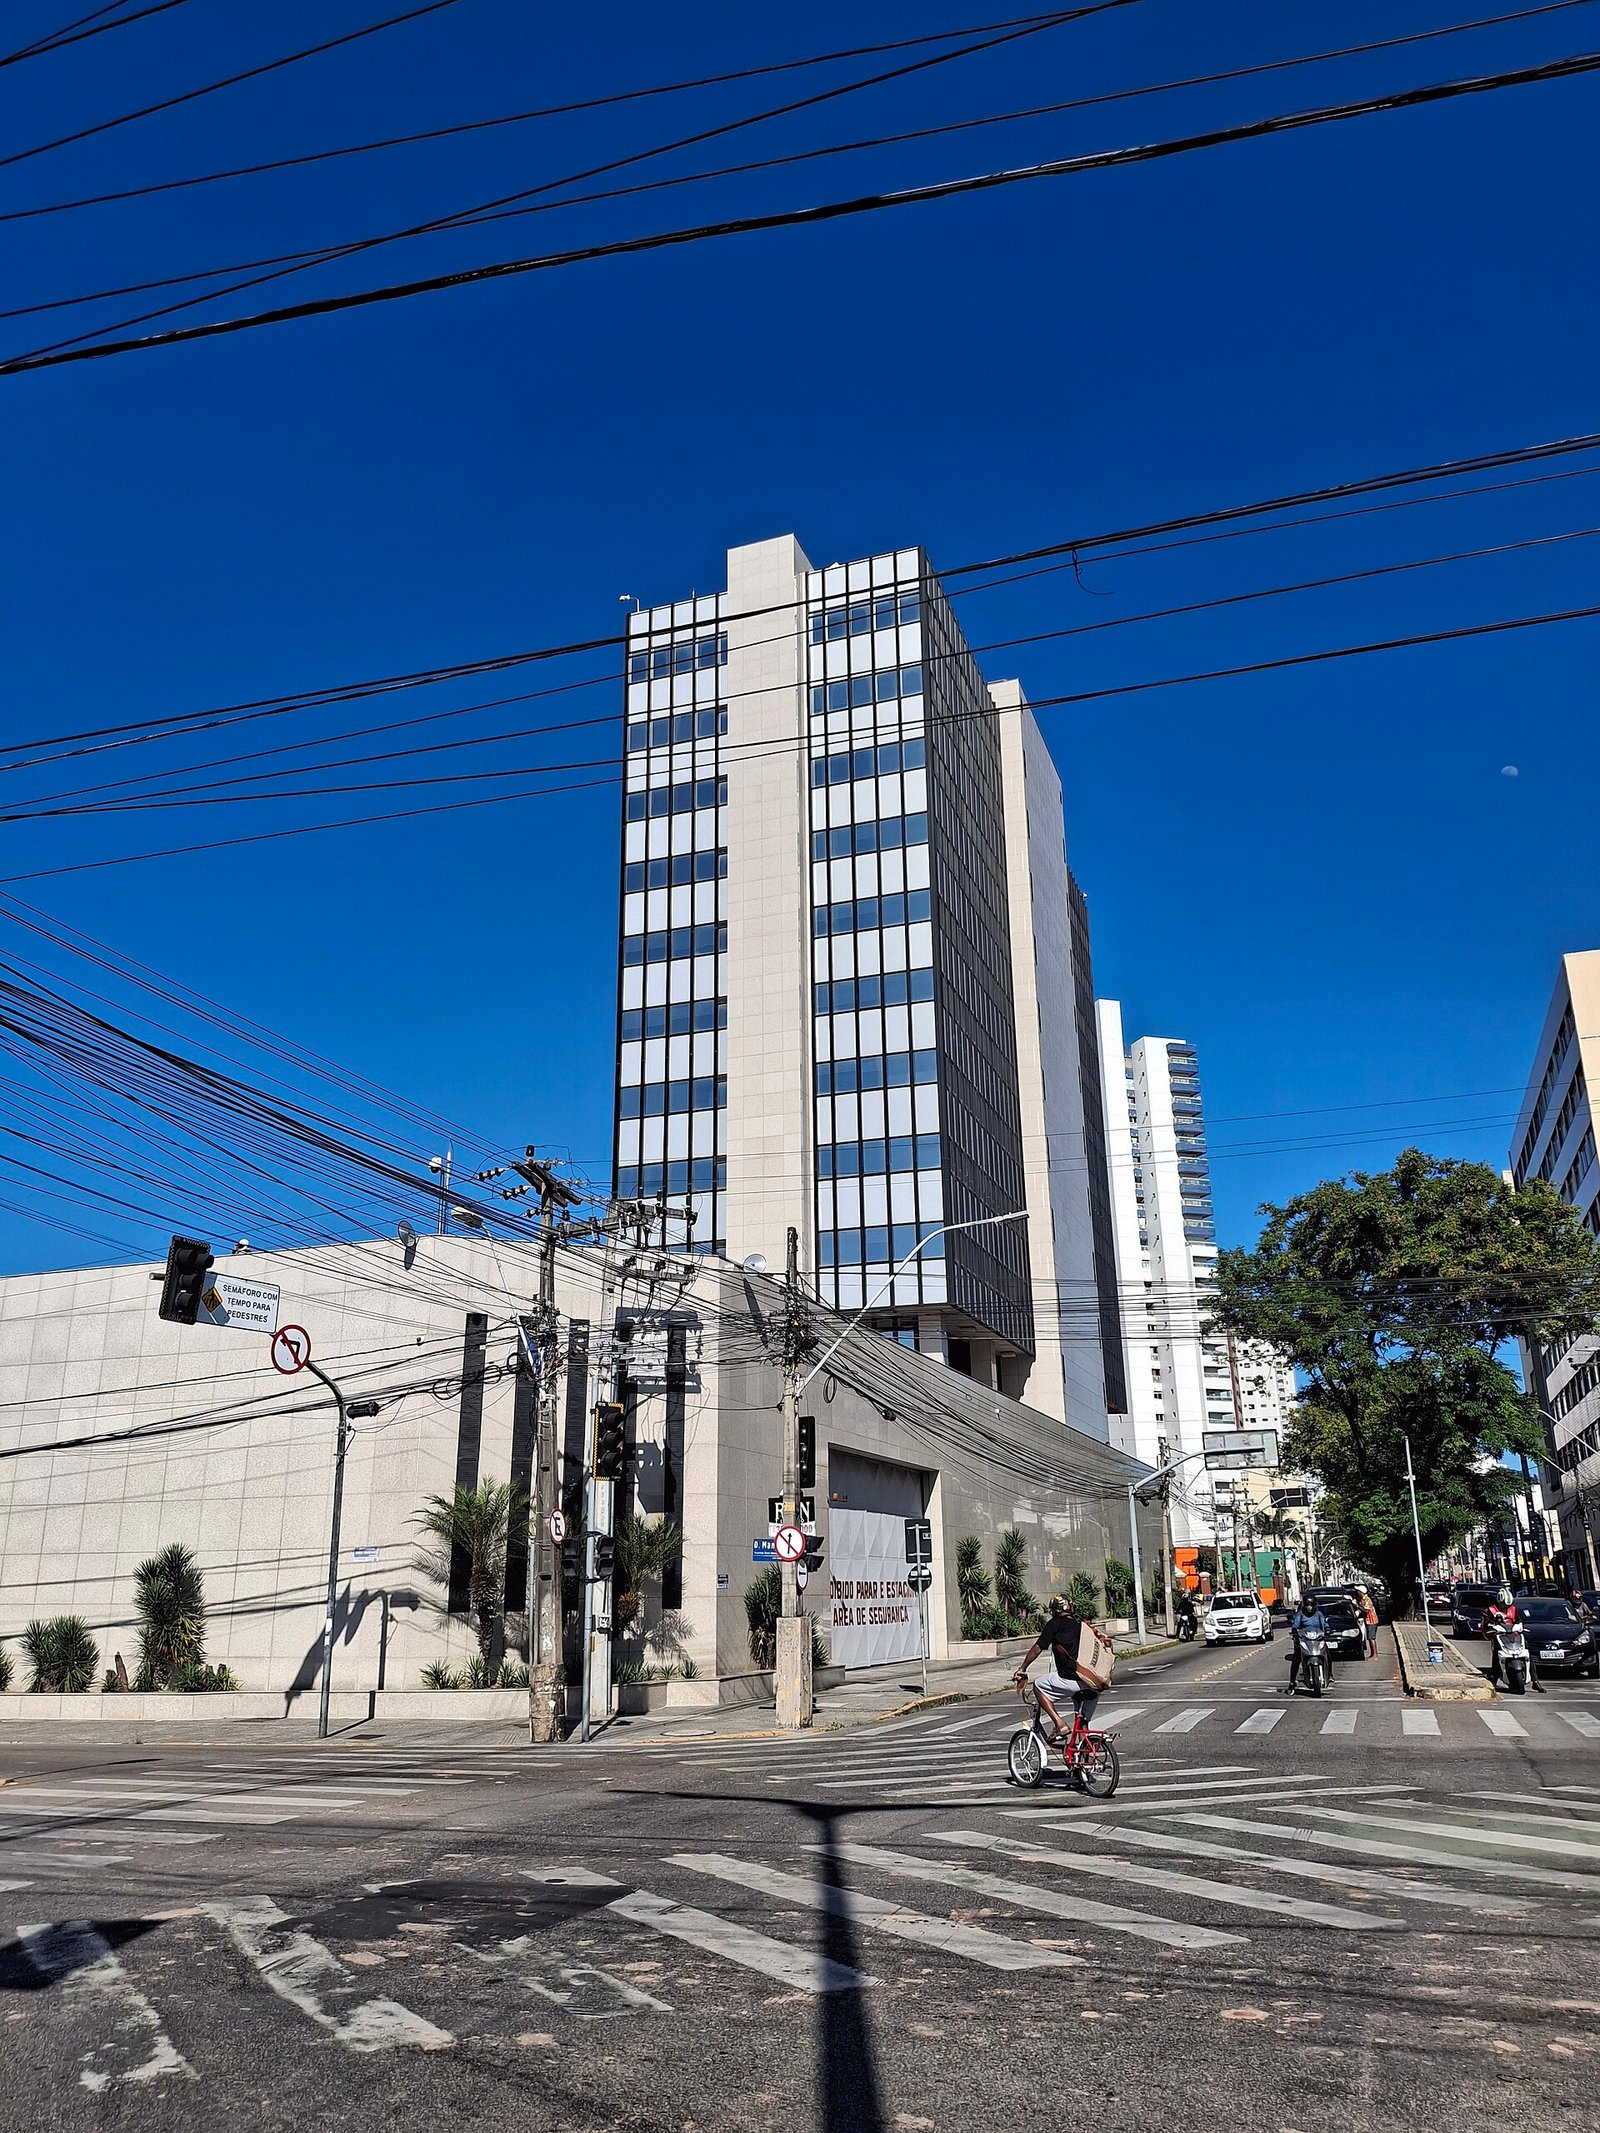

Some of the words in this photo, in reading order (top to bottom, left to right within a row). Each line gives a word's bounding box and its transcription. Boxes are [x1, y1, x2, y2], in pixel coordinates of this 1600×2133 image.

[223, 1284, 262, 1298] SEMÁFORO
[262, 1292, 278, 1301] COM
[227, 1297, 251, 1308] TEMPO
[252, 1302, 271, 1311] PARA
[227, 1310, 268, 1323] PEDESTRES
[856, 1580, 878, 1600] PARAR
[833, 1603, 854, 1626] ÁREA
[856, 1607, 867, 1626] DE
[868, 1605, 909, 1626] SEGURANÇA
